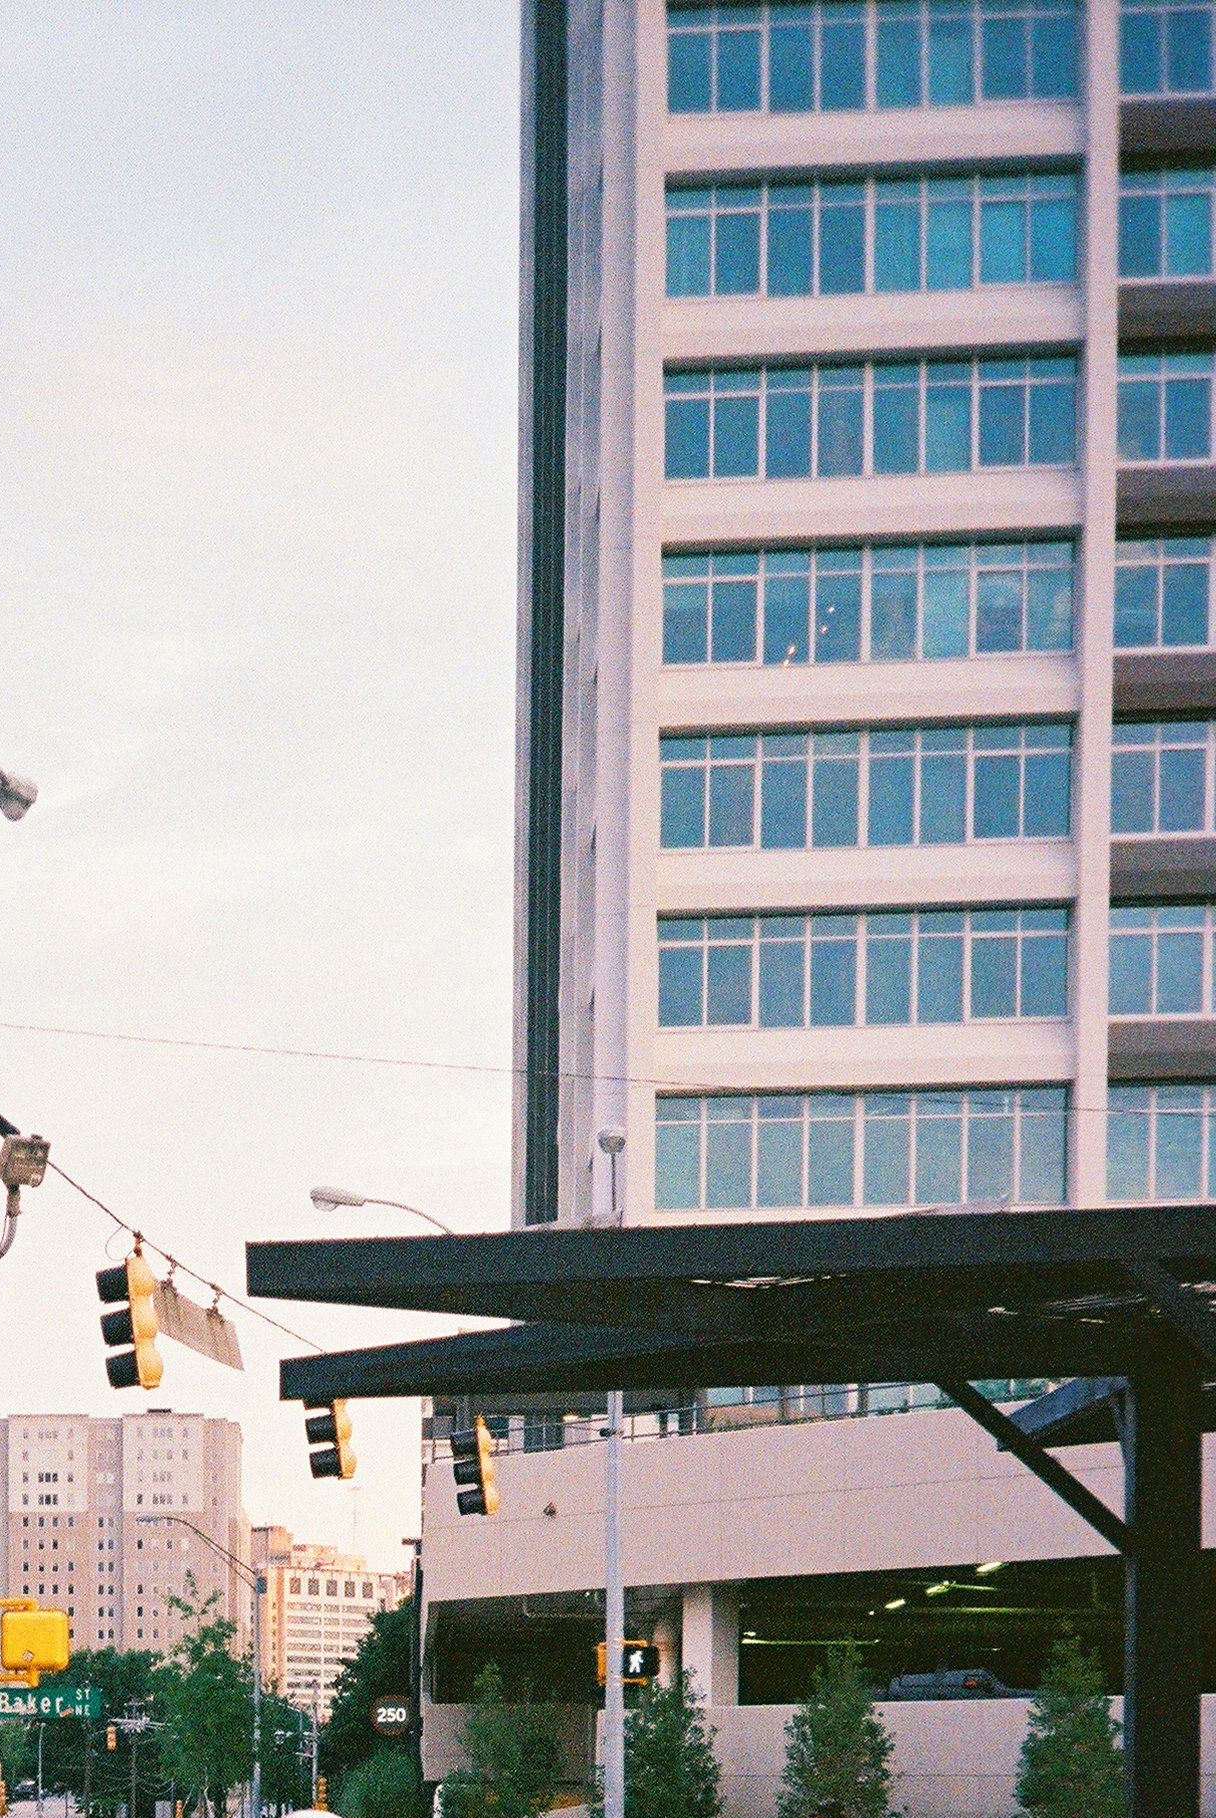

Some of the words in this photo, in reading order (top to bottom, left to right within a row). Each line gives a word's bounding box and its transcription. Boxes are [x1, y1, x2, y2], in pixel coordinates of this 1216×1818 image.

[76, 1688, 90, 1700] ST
[75, 1704, 90, 1716] NE
[377, 1707, 406, 1722] 250
